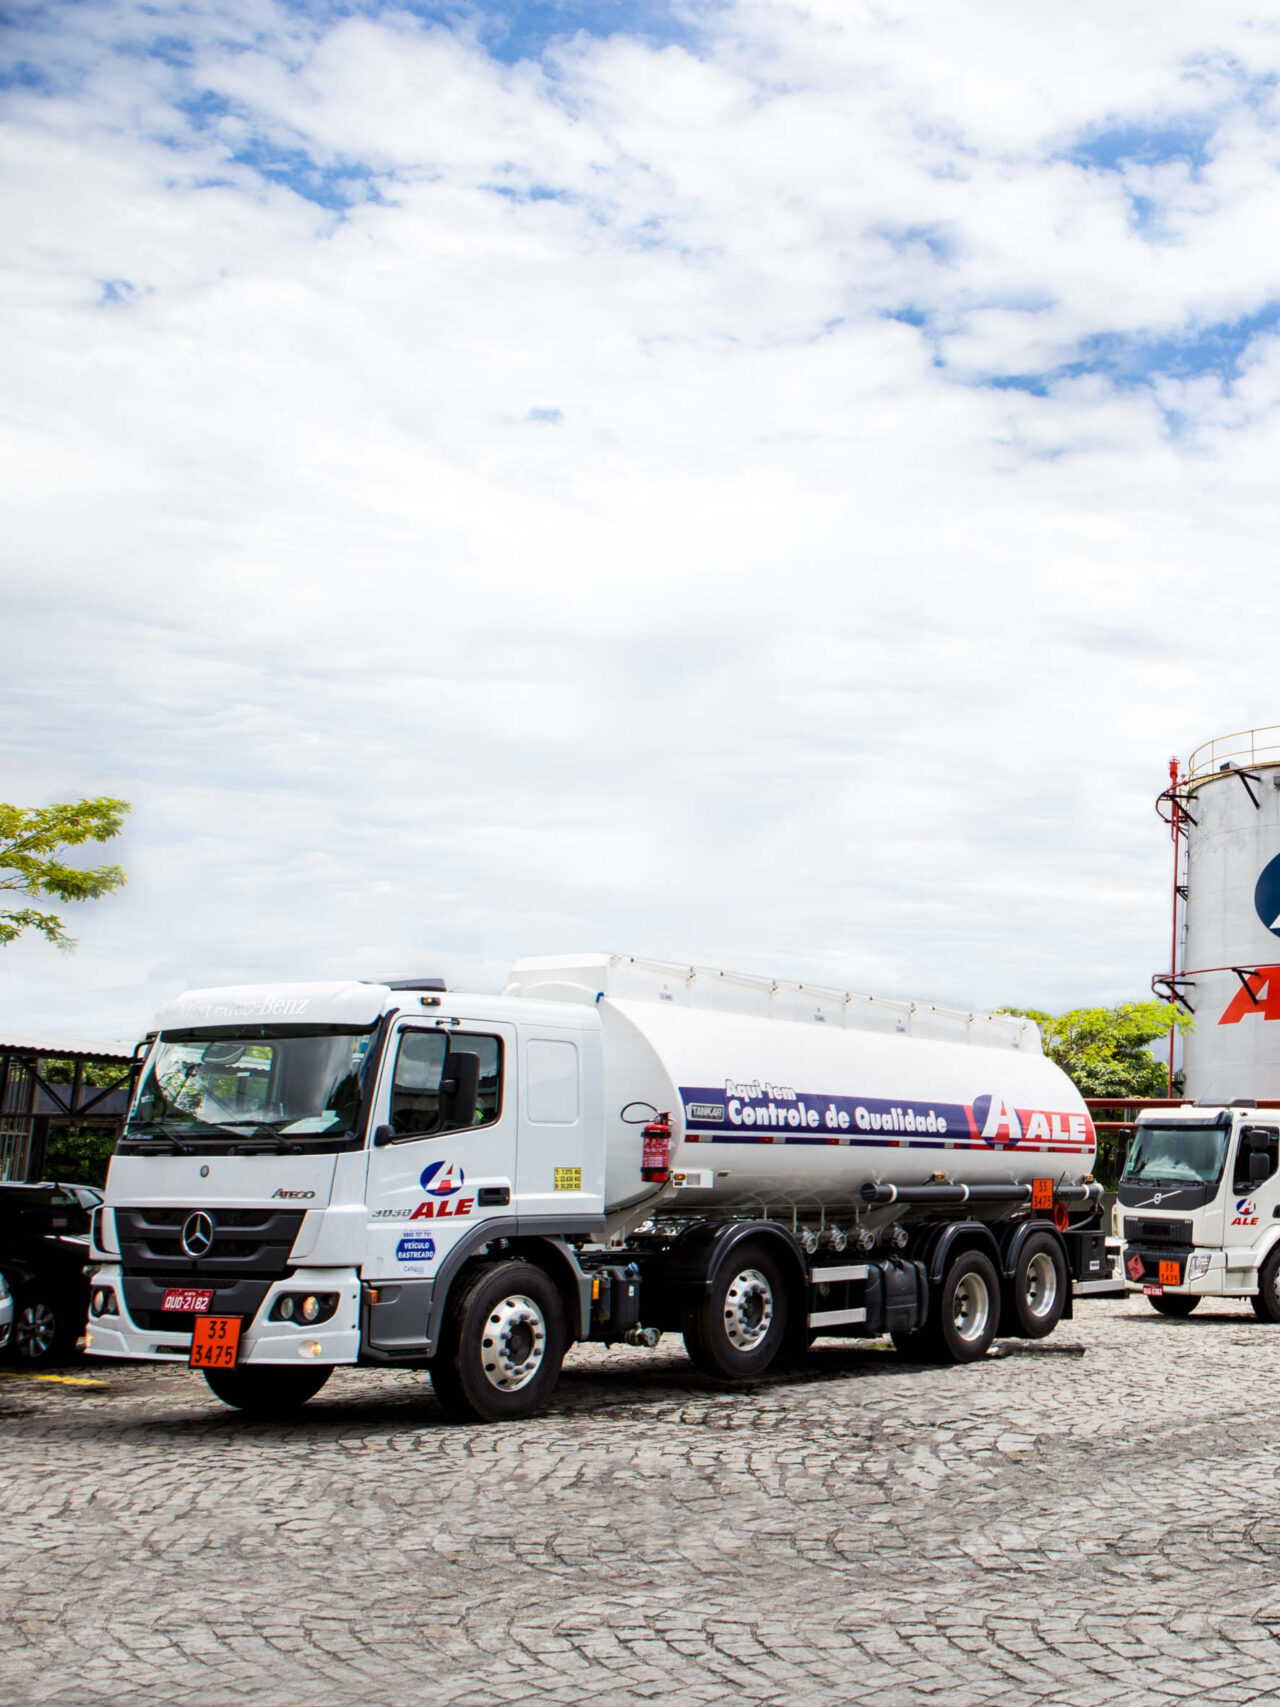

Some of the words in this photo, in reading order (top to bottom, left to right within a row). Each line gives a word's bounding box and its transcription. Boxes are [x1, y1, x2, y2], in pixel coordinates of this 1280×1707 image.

[727, 1100, 820, 1128] Controle
[825, 1104, 850, 1129] de
[854, 1106, 947, 1134] Qualidade
[1025, 1112, 1086, 1141] ALE
[409, 1198, 475, 1220] ALE
[1231, 1217, 1259, 1226] ALE
[397, 1250, 434, 1259] RASTREADO
[207, 1320, 228, 1339] 33
[194, 1345, 233, 1365] 3475
